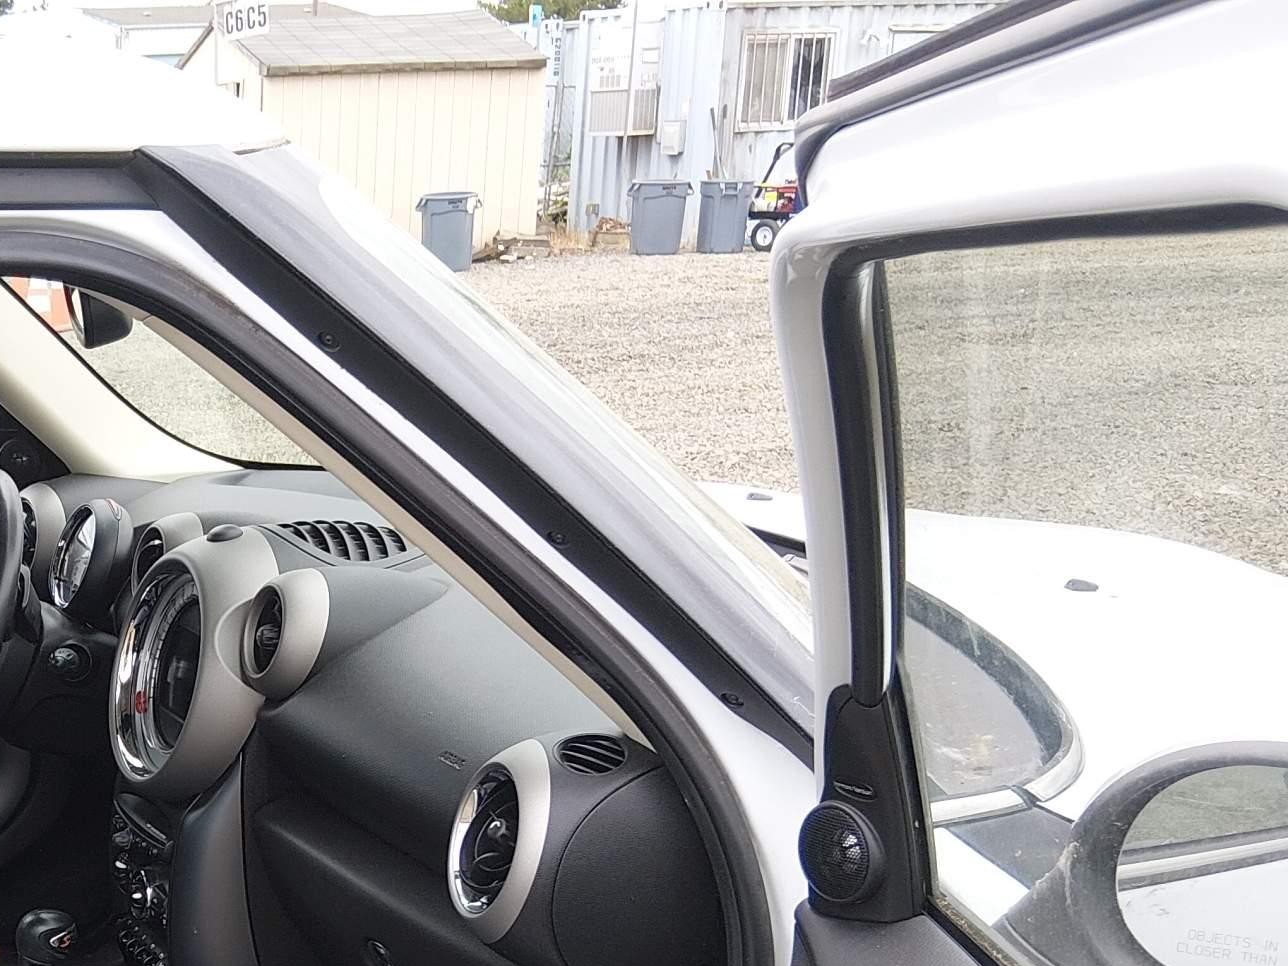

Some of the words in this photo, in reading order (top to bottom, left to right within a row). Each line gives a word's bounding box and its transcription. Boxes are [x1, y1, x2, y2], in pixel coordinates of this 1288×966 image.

[226, 9, 243, 34] C6
[247, 4, 266, 29] C5
[1187, 928, 1251, 948] OBJECTS
[1264, 939, 1279, 952] IN
[1176, 942, 1232, 959] CLOSER
[1241, 951, 1278, 966] THAN
